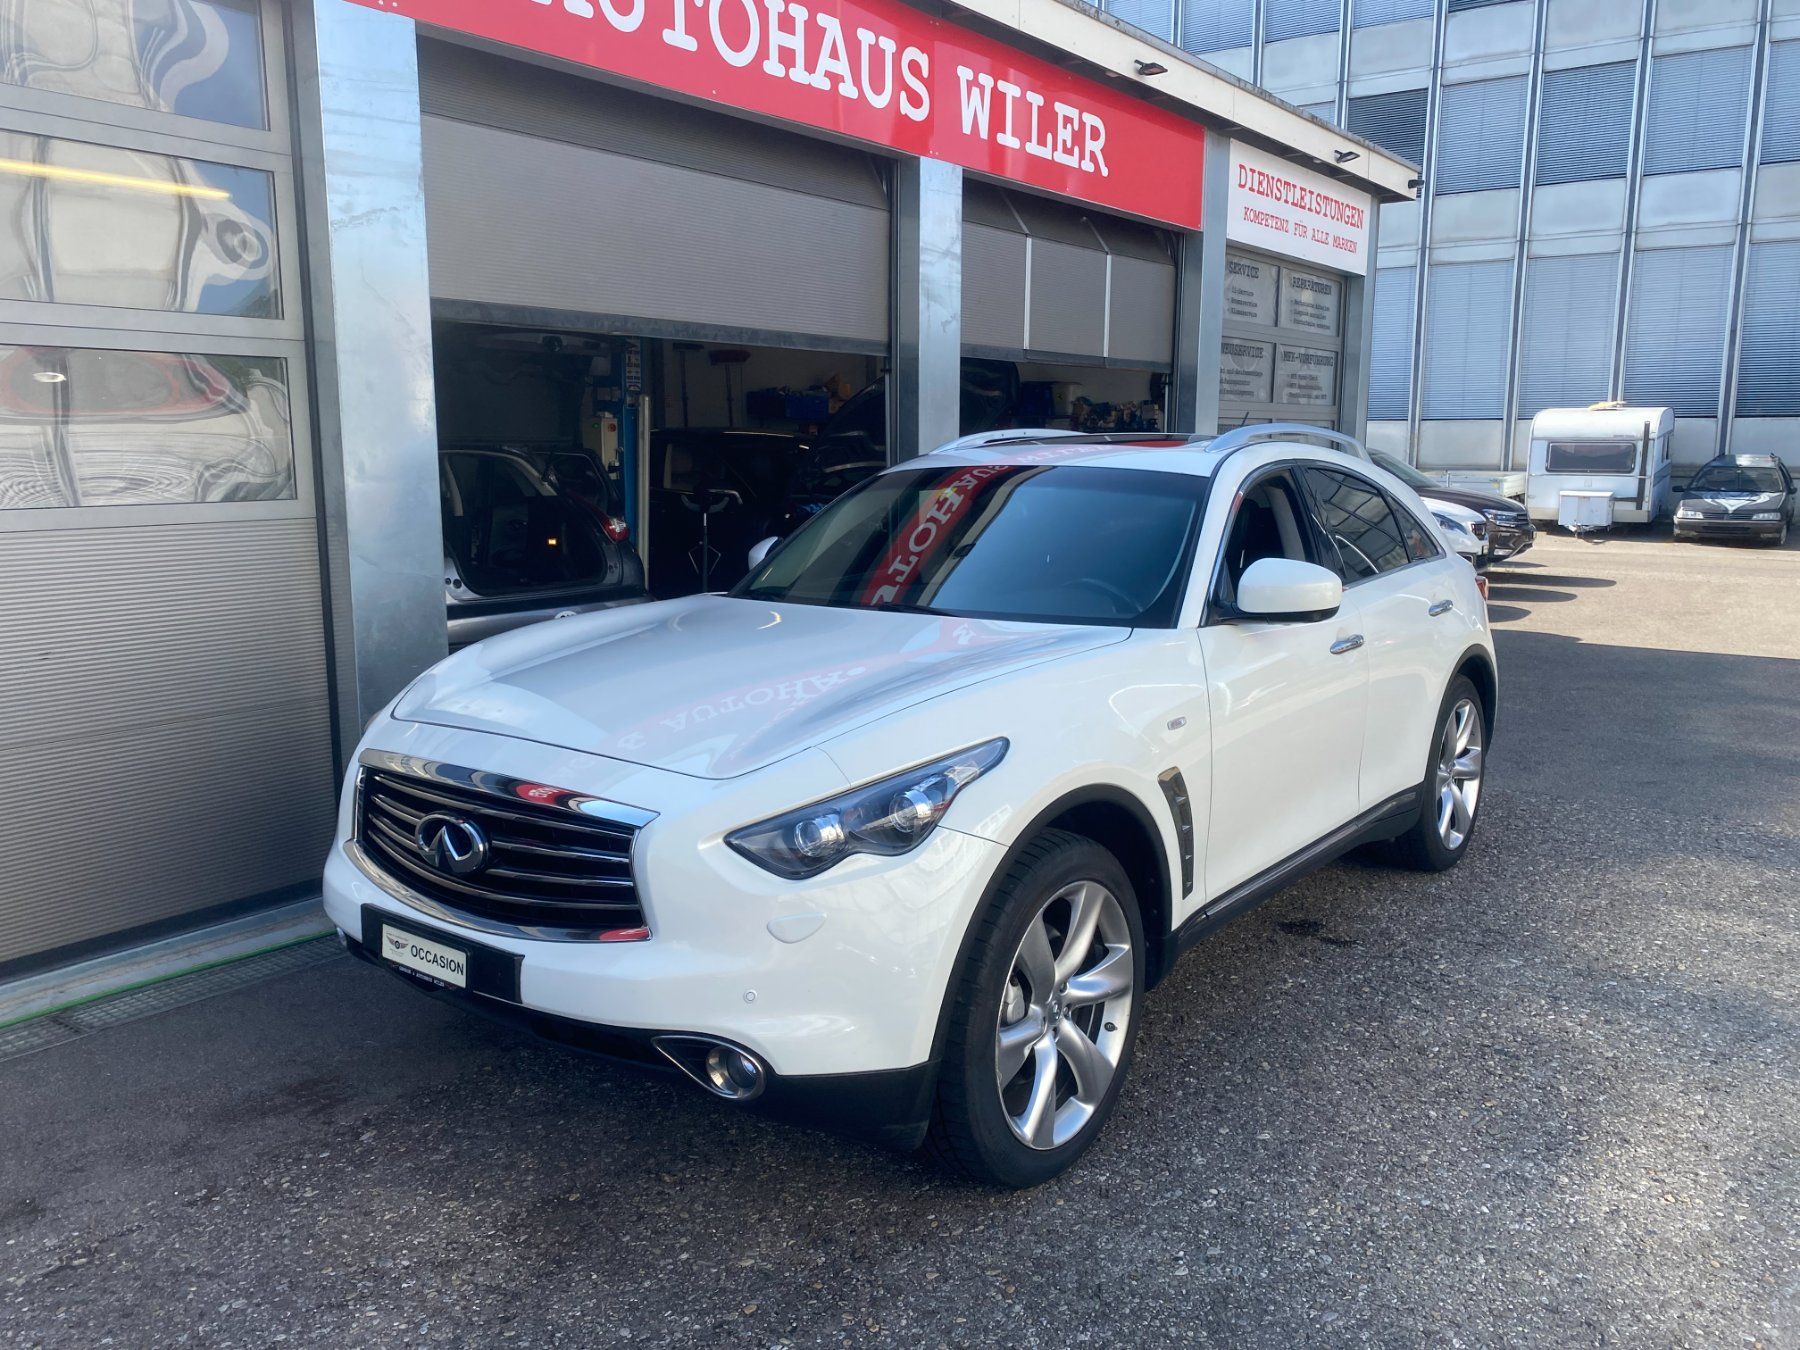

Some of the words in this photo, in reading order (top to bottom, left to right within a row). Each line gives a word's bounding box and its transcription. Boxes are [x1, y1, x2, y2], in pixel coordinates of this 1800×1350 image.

[528, 0, 931, 123] TOHAUS
[956, 64, 1109, 178] WILER
[1237, 163, 1364, 230] DIENSTLEISTUNGEN
[1243, 206, 1289, 234] KOMPETENZ
[1293, 219, 1308, 240] FÜR
[1311, 227, 1330, 247] ALLE
[1332, 234, 1357, 254] MARKEN
[410, 944, 465, 976] OCCASION
